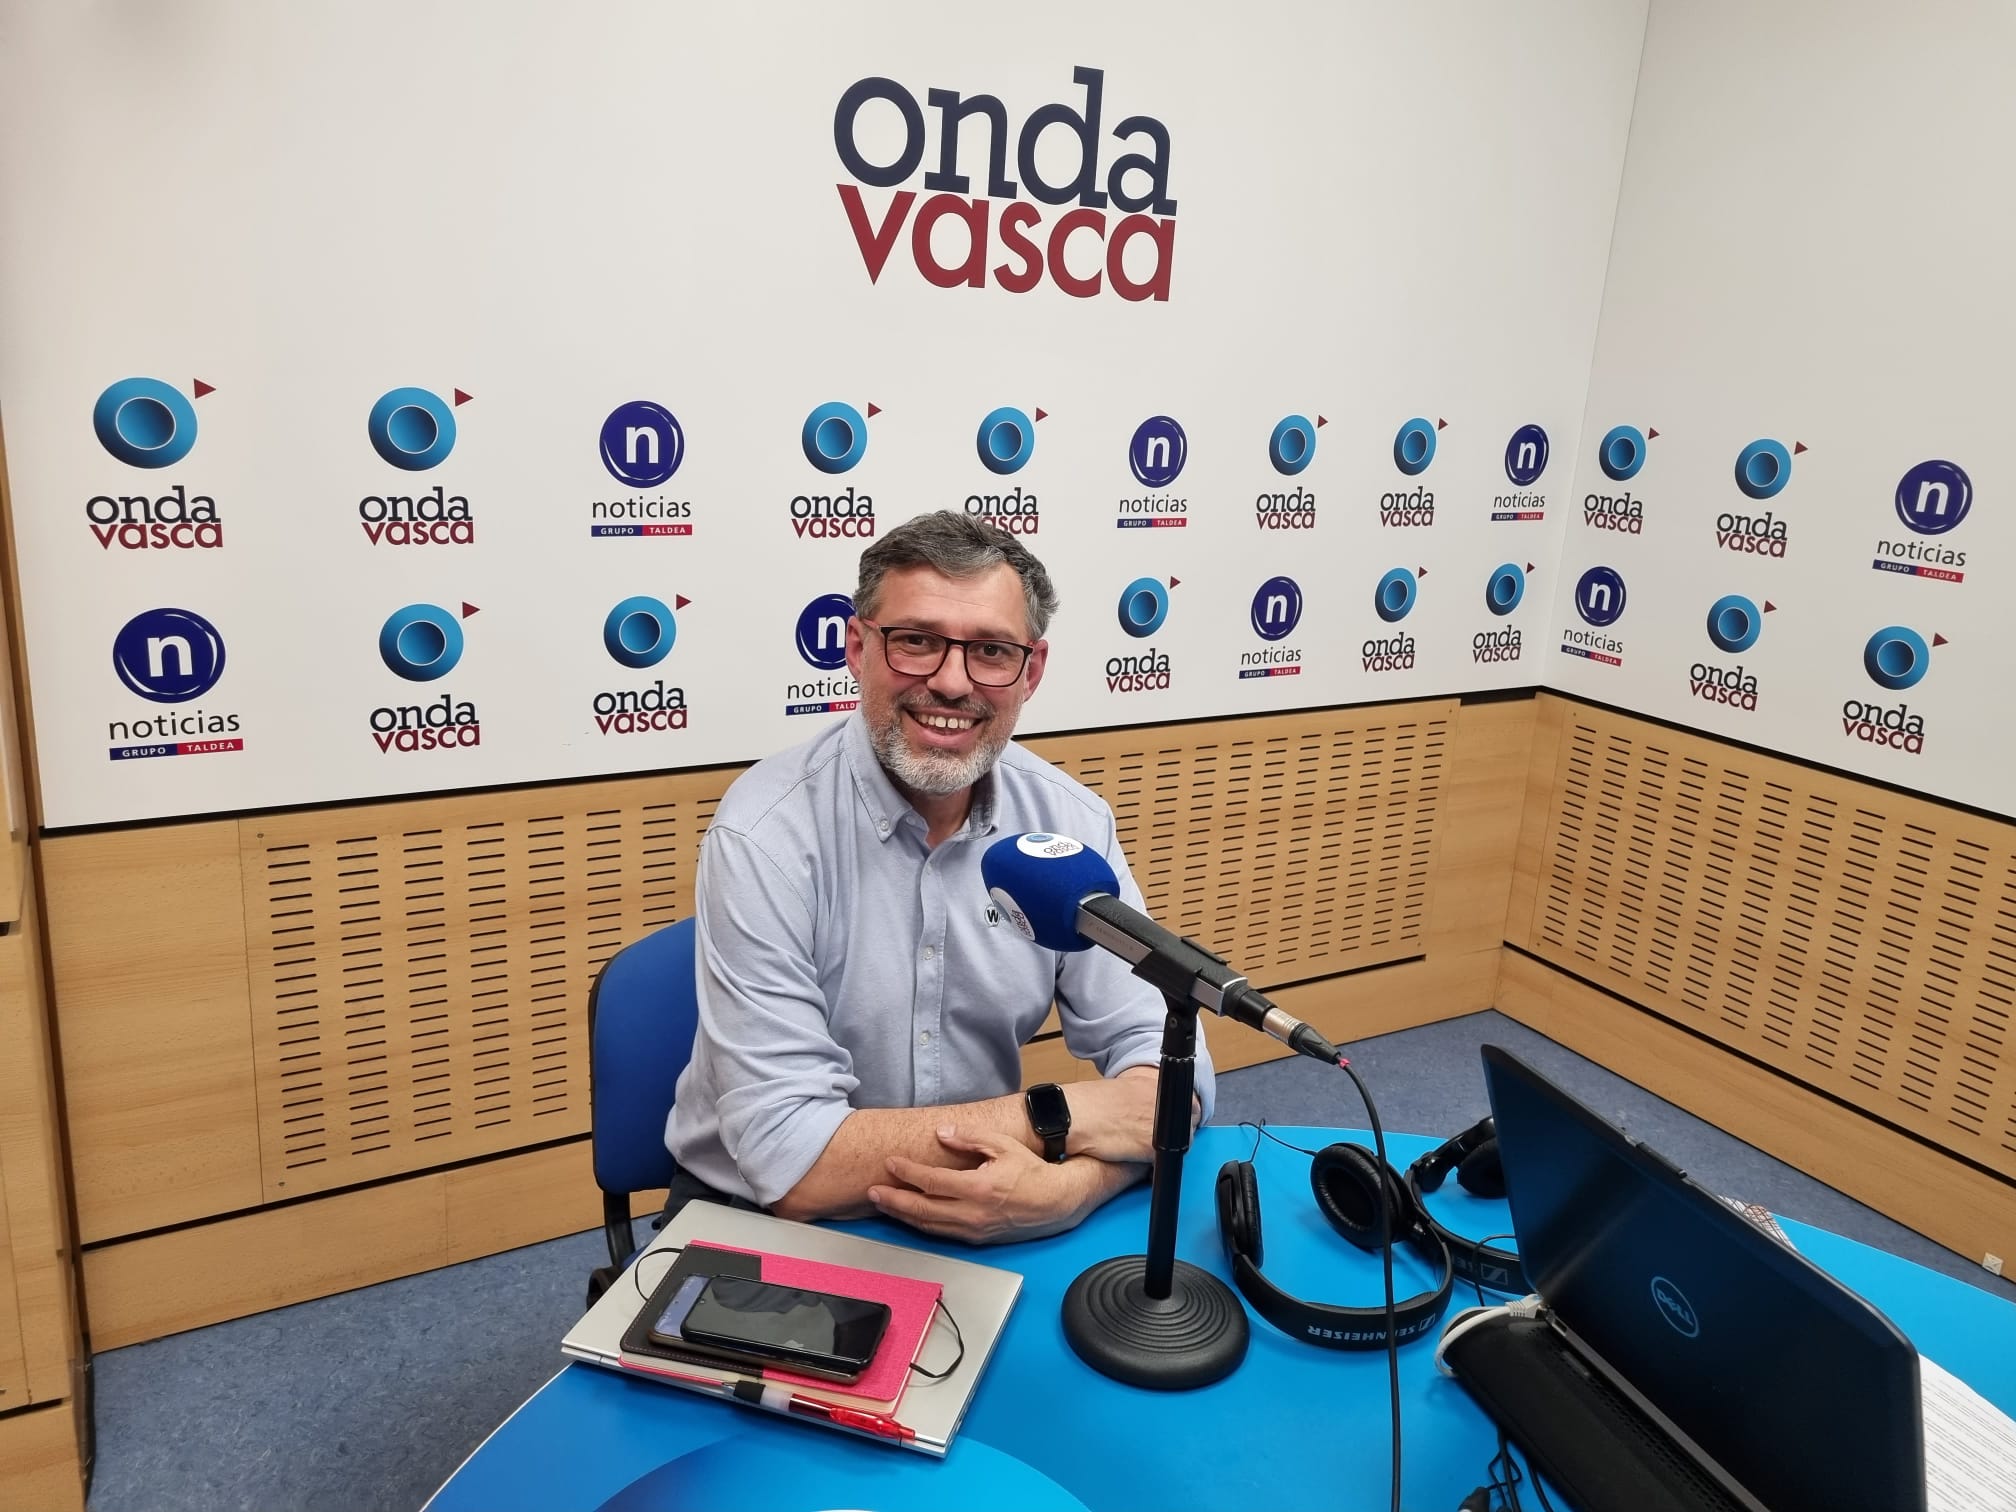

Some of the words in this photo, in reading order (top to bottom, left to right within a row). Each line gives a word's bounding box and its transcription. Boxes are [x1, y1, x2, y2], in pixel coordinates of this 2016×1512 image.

[834, 65, 1177, 217] onda
[836, 183, 1176, 302] vasca
[86, 485, 222, 524] onda
[359, 486, 473, 523] onda
[591, 496, 692, 519] noticias
[790, 487, 875, 518] onda
[964, 487, 1039, 516] onda
[1119, 494, 1187, 513] noticias
[1256, 486, 1316, 513] onda
[1380, 486, 1434, 512] onda
[1494, 492, 1545, 508] noticias
[1584, 492, 1643, 519] onda
[791, 515, 875, 538] vasca
[978, 514, 1039, 535] asca
[1123, 519, 1147, 527] GRUPO
[1157, 519, 1183, 527] TALDEA
[1256, 510, 1316, 530] vasca
[1380, 508, 1434, 527] vasca
[1520, 512, 1541, 520] TALDEA
[1584, 510, 1643, 535] vasca
[1716, 512, 1787, 541] onda
[89, 522, 223, 549] vasca
[362, 521, 473, 545] vasca
[600, 526, 635, 535] GRUPO
[649, 526, 687, 535] TALDEA
[1716, 530, 1787, 558] vasca
[1876, 539, 1967, 567] noticias
[1880, 562, 1910, 573] GRUPO
[1923, 569, 1958, 582] TALDEA
[1362, 632, 1416, 657] onda
[1473, 625, 1522, 648] onda
[1563, 628, 1623, 654] noticias
[1106, 648, 1170, 675] onda
[1241, 646, 1302, 665] noticias
[1362, 653, 1415, 673] vasca
[1473, 644, 1521, 664] vasca
[1566, 646, 1586, 658] GRUPO
[1594, 653, 1618, 665] TALDEA
[1106, 671, 1170, 693] vasca
[1244, 669, 1265, 677] GRUPO
[1274, 667, 1297, 675] TALDEA
[1690, 662, 1758, 695] onda
[593, 680, 688, 713] onda
[787, 676, 861, 699] noticia
[1690, 678, 1758, 712] vasca
[370, 694, 480, 730] onda
[793, 704, 823, 714] GRUPO
[834, 702, 856, 711] TALD
[1843, 699, 1925, 737] onda
[109, 709, 240, 740] noticias
[595, 708, 688, 735] vasca
[121, 745, 166, 757] GRUPO
[186, 740, 235, 752] TALDEA
[371, 724, 480, 754] vasca
[1843, 717, 1924, 755] vasca
[986, 909, 999, 923] W
[1307, 1325, 1417, 1341] SENHEISER
